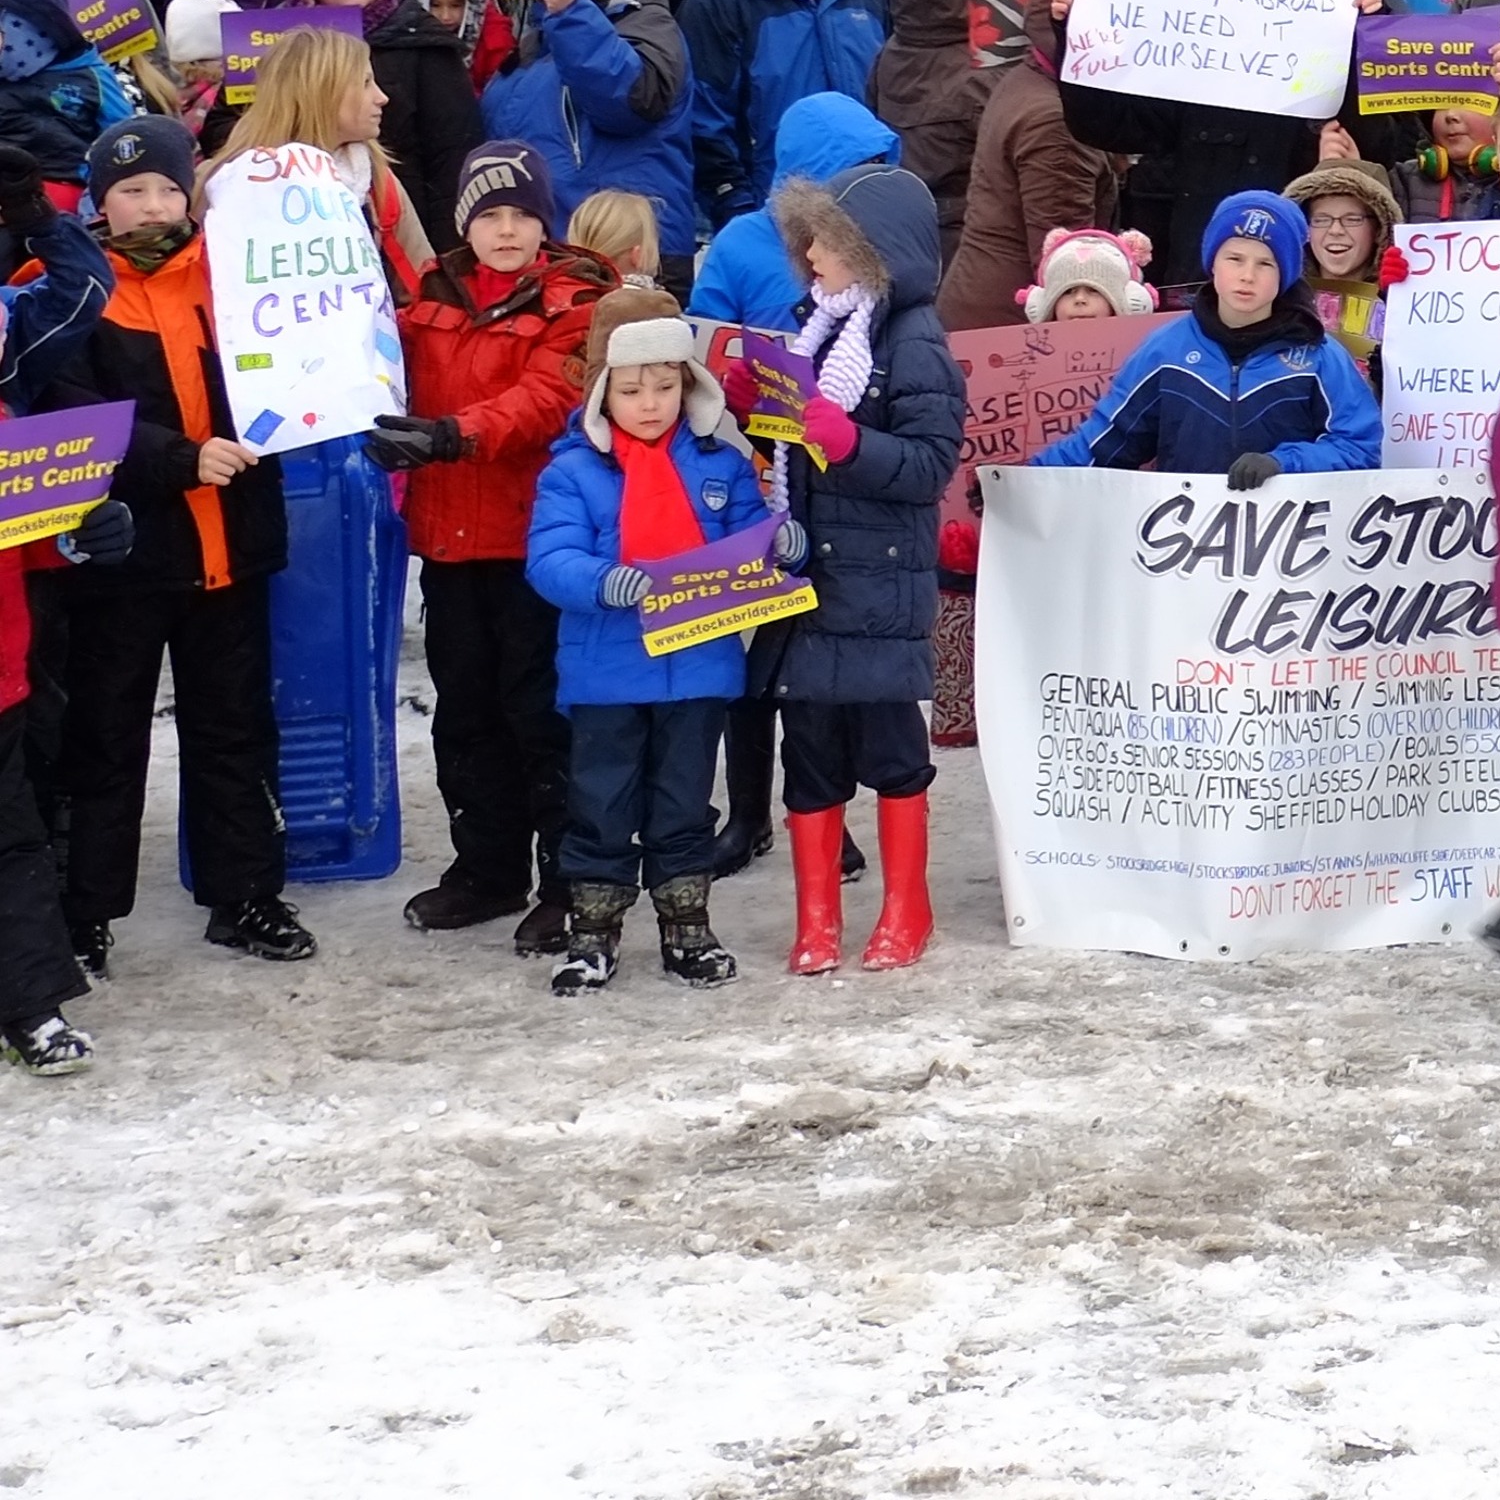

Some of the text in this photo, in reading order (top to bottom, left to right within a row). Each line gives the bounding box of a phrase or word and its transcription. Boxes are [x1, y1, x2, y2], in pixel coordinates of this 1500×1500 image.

[1109, 2, 1293, 41] WE NEED IT
[1133, 39, 1299, 82] OURSELVES
[1386, 38, 1474, 55] Save our
[1070, 52, 1128, 80] FULL
[1361, 61, 1428, 78] Sports
[1367, 93, 1493, 110] www.stocksbridge.com
[247, 146, 342, 182] SAVE
[281, 184, 364, 225] OUR
[1408, 291, 1465, 325] KIDS
[1398, 366, 1474, 394] WHERE
[1390, 412, 1438, 442] SAVE
[0, 436, 95, 470] Save our
[42, 460, 115, 488] Centre
[1136, 494, 1331, 578] SAVE
[672, 569, 729, 585] Save
[642, 584, 722, 614] Sports
[654, 594, 808, 648] www.stocksbridge.com
[1176, 659, 1255, 685] DON'T
[1271, 659, 1318, 686] LET
[1328, 656, 1368, 681] THE
[1376, 651, 1465, 678] COUNCIL
[1040, 673, 1453, 715] GENERAL PUBLIC SWIMMING SWIMMING
[1042, 704, 1125, 739] PENTAQUA
[1121, 743, 1179, 770] SENIOR
[1183, 746, 1265, 773] SESSIONS
[1106, 768, 1188, 798] FOOTBALL
[1288, 769, 1362, 797] CLASSES
[1386, 762, 1431, 788] PARK
[1034, 789, 1111, 823] SQUASH
[1141, 799, 1235, 831] ACTIVITY
[1246, 798, 1346, 831] SHEFFIELD
[1351, 792, 1430, 821] HOLIDAY
[1438, 788, 1500, 813] CLUBS
[1292, 873, 1356, 912] FORGET
[1365, 870, 1400, 904] THE
[1411, 866, 1473, 902] STAFF
